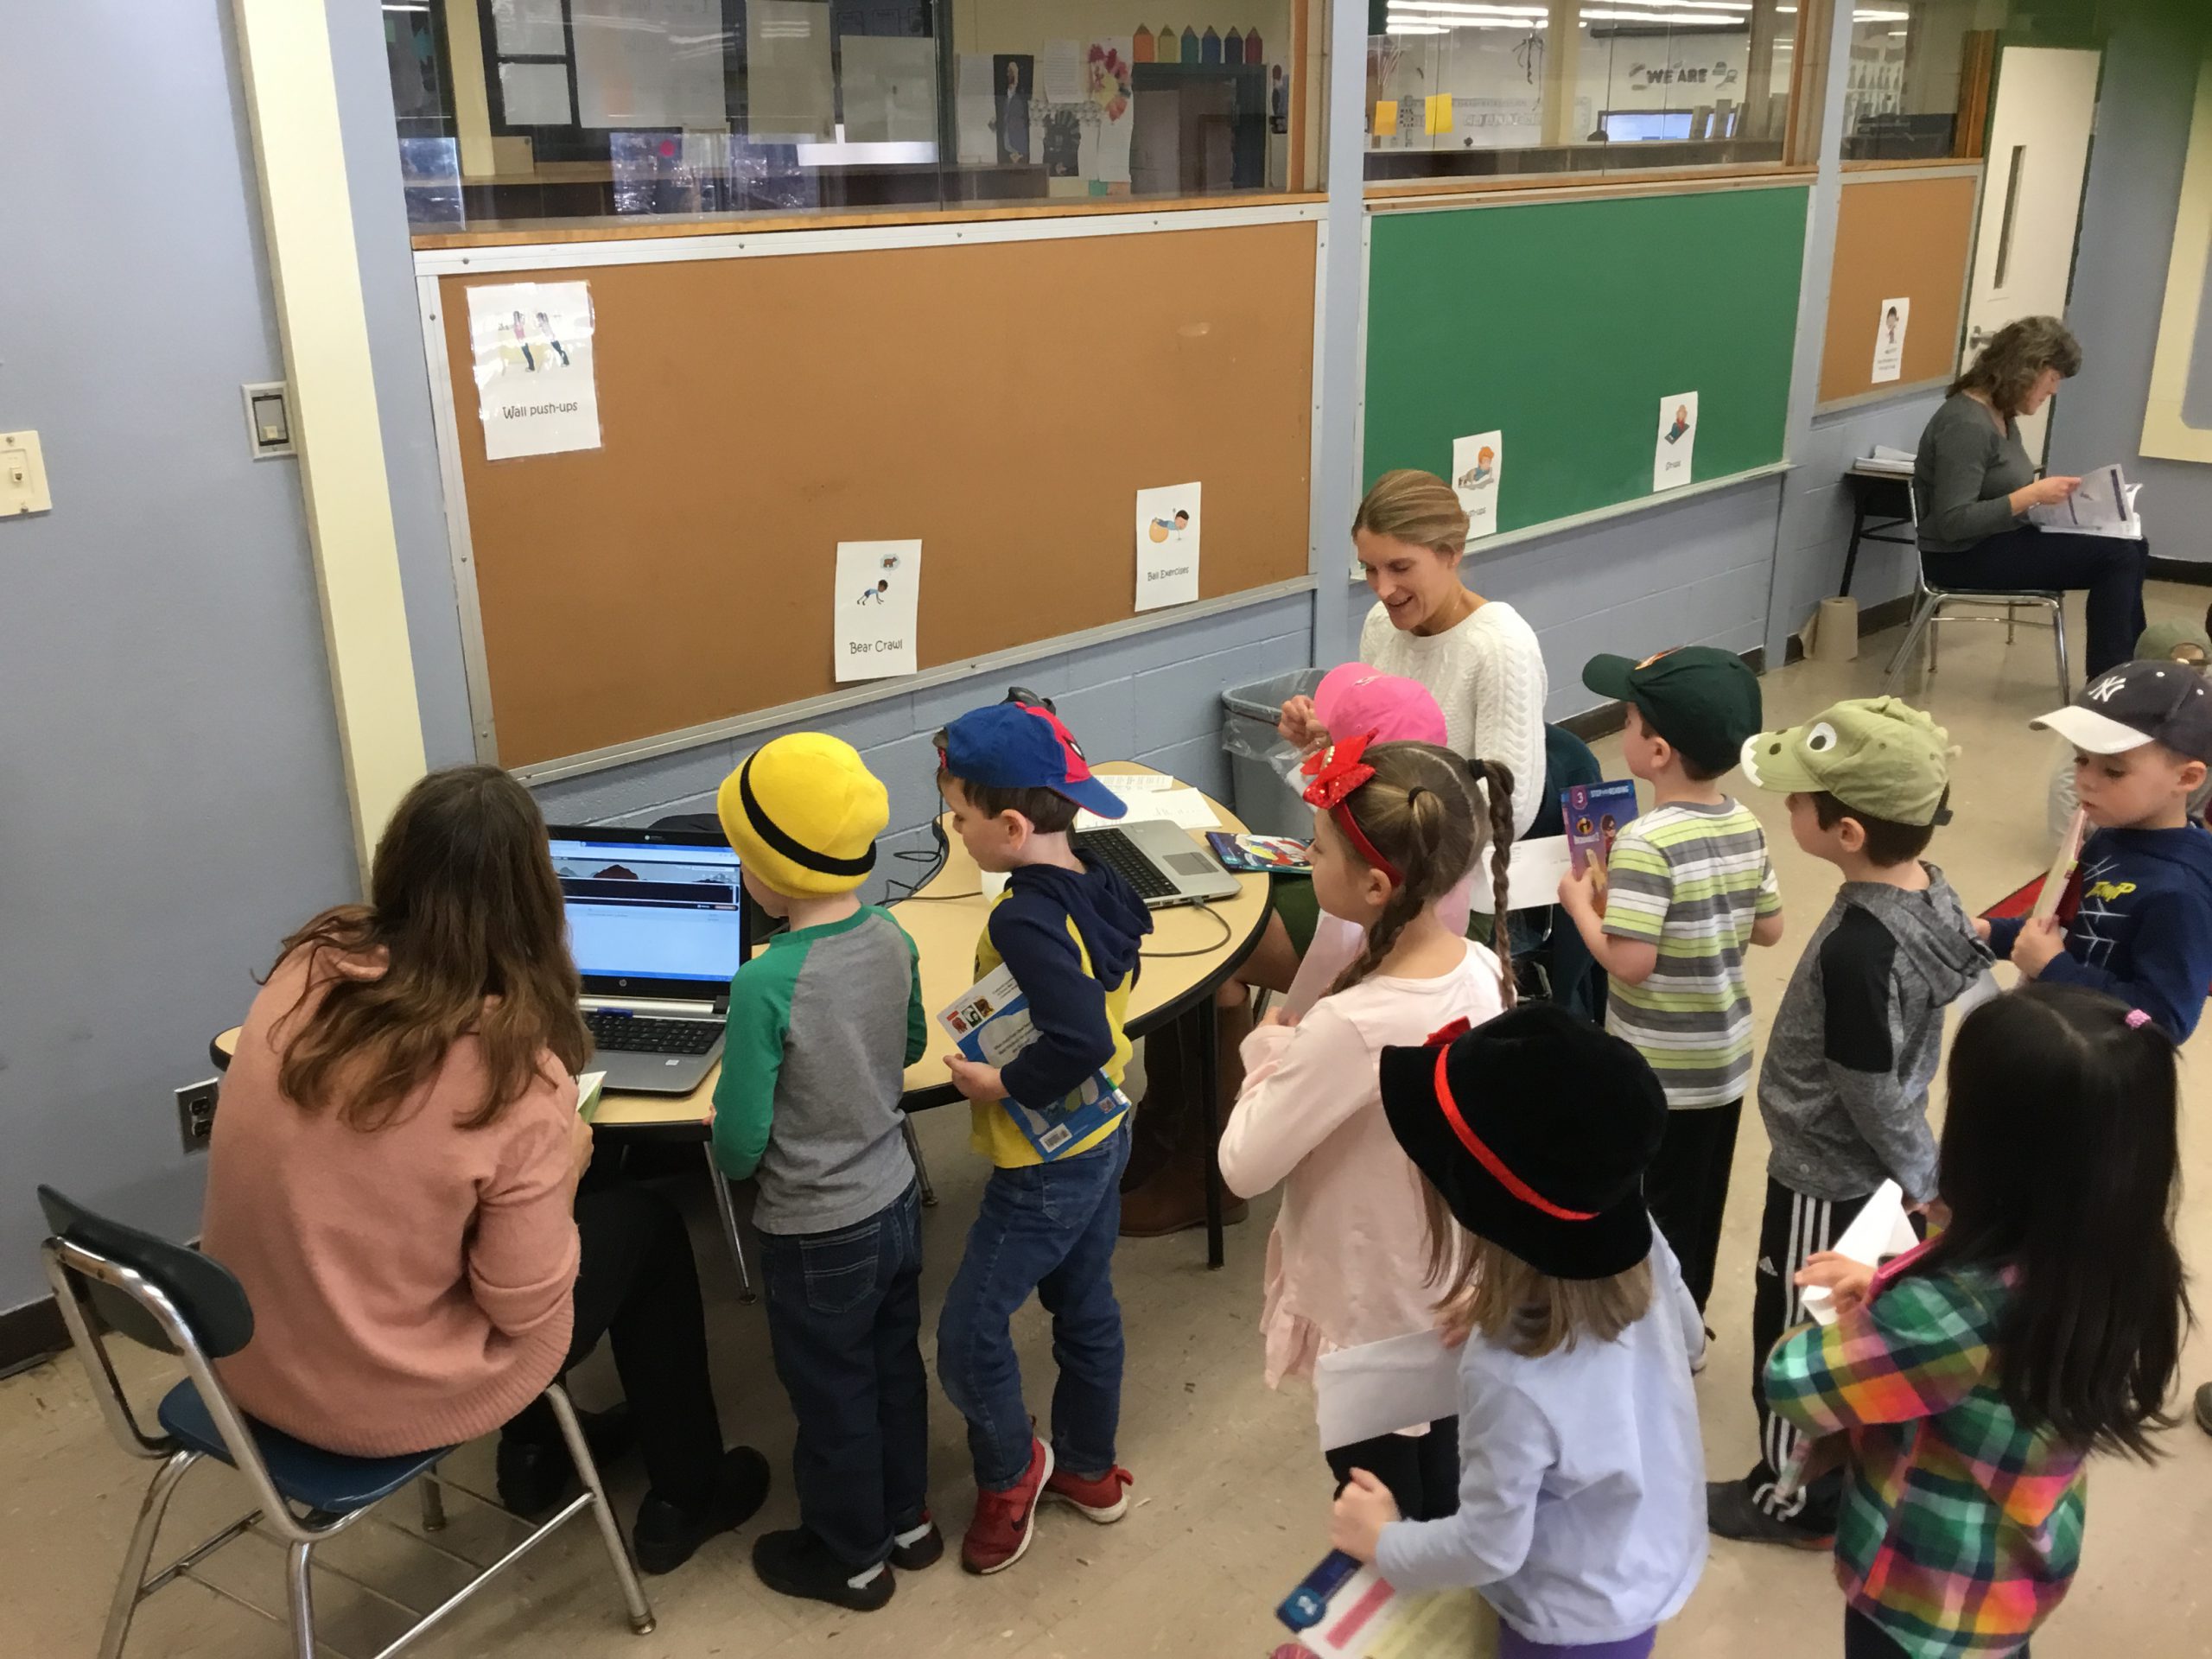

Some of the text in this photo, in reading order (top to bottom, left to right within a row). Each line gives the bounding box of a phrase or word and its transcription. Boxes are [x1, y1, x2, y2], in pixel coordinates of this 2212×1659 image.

[1646, 67, 1708, 84] WE ARE
[502, 402, 578, 419] Wall push-ups
[1147, 567, 1189, 582] Ball Exercises
[849, 639, 903, 654] Bear Crawl
[2087, 676, 2126, 702] NY
[1577, 791, 1584, 804] 3
